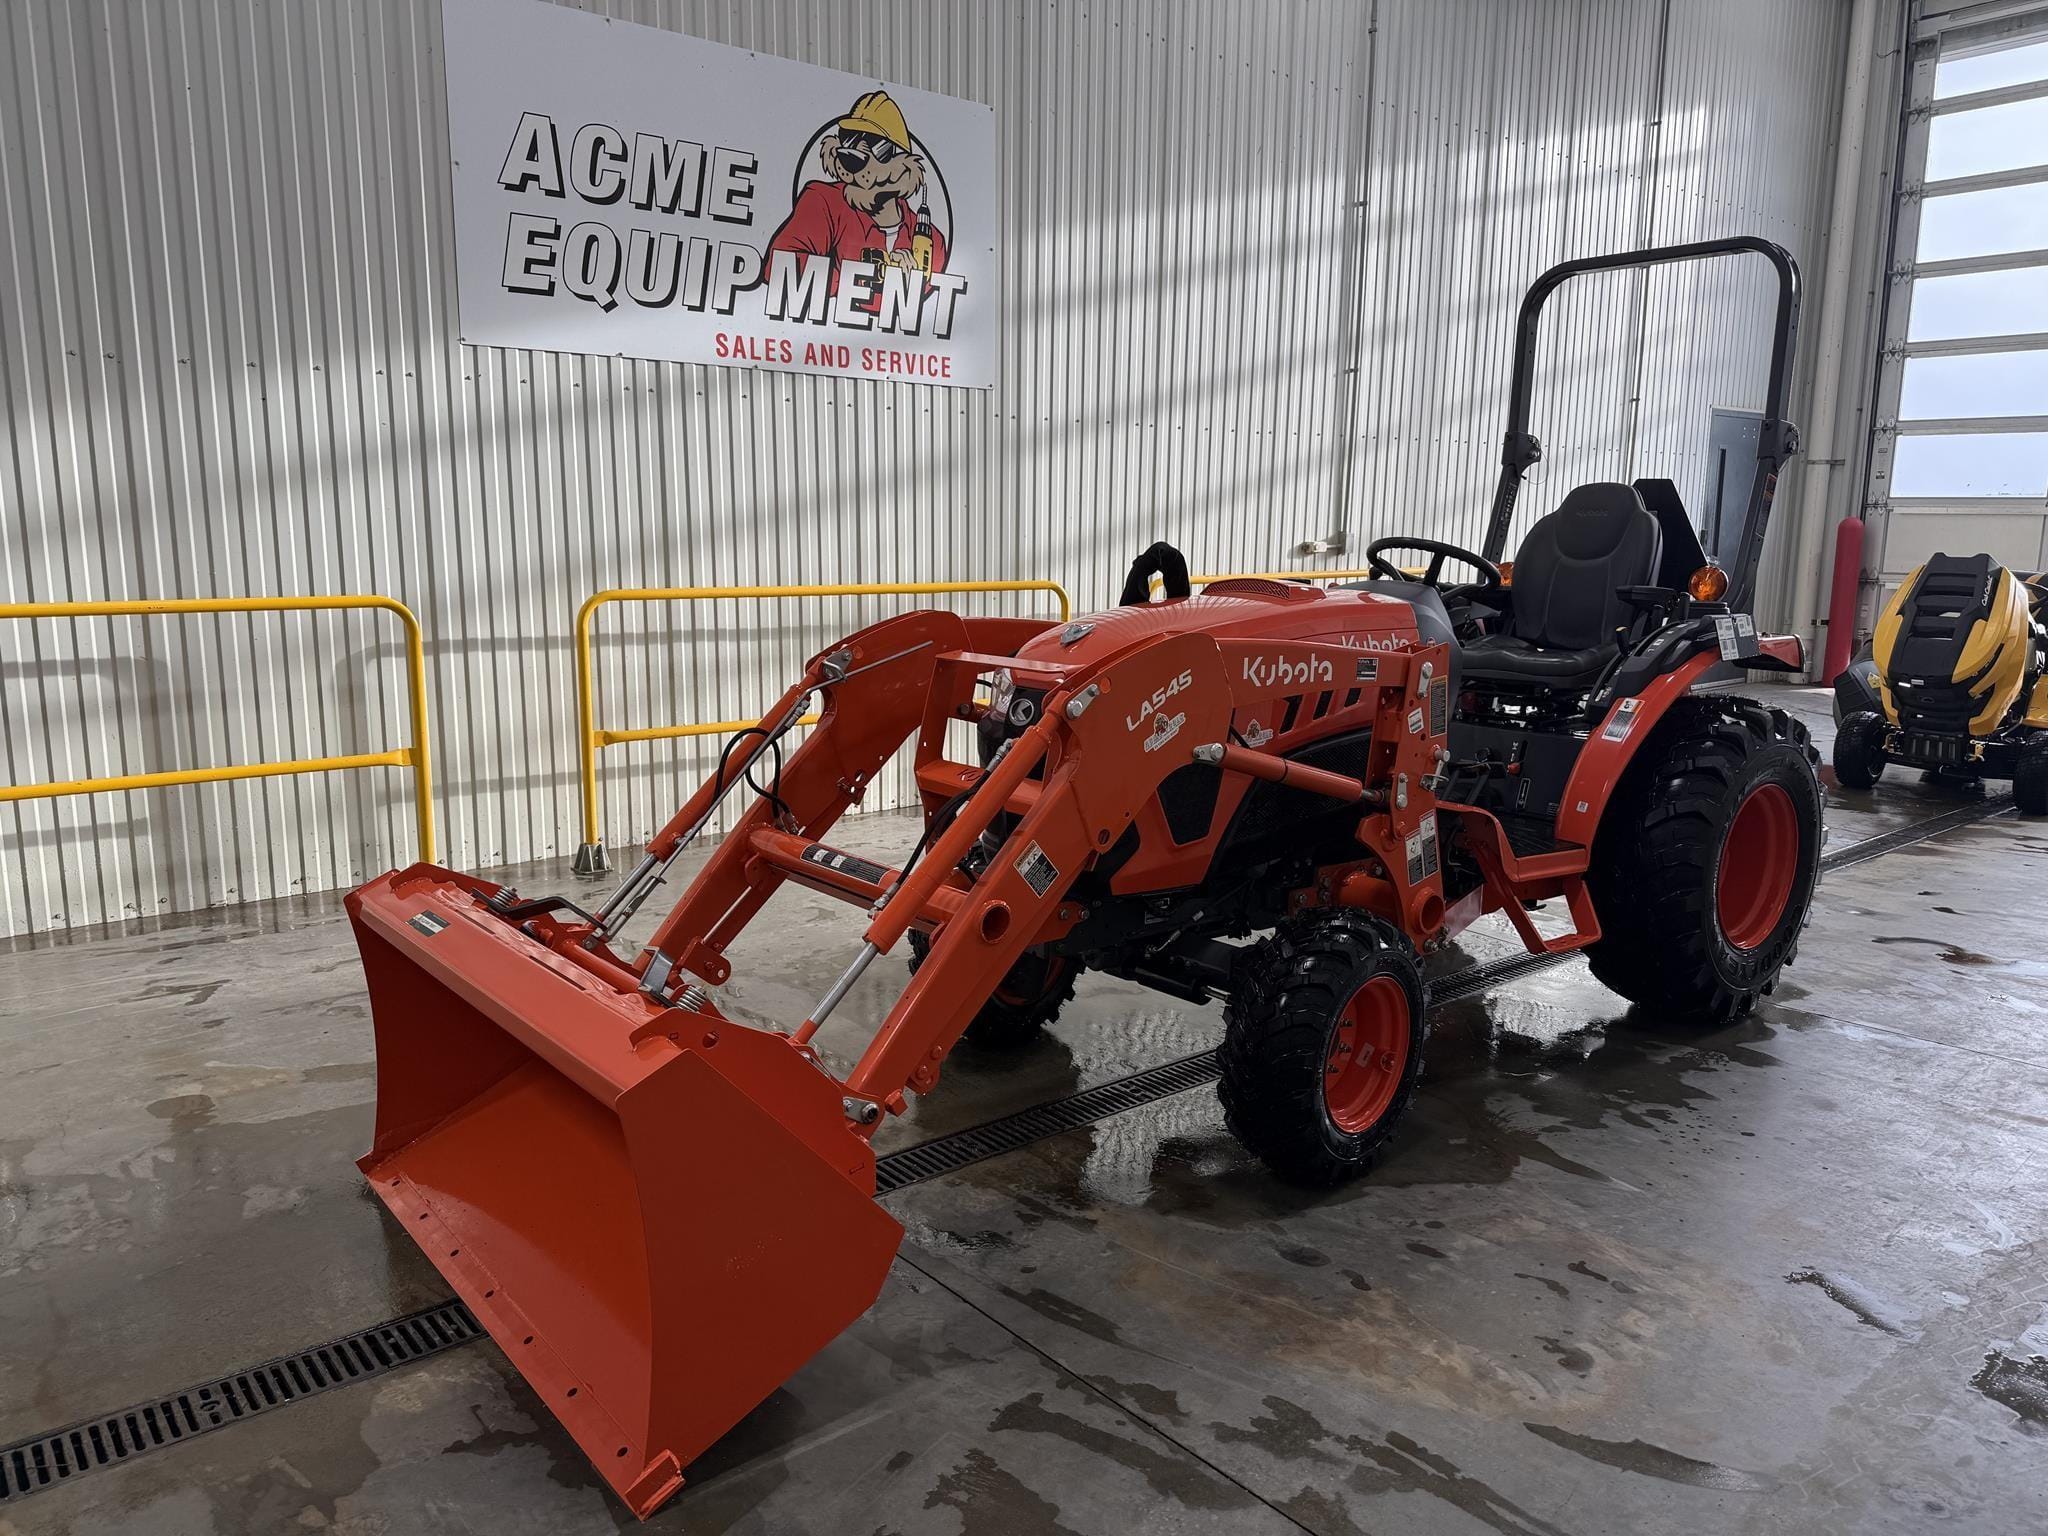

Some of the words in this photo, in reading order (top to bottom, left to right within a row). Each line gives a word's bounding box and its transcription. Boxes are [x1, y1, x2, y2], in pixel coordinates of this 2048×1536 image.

[498, 111, 758, 226] ACME
[502, 212, 968, 340] EQUIPMENT
[715, 332, 793, 364] SALES
[804, 342, 850, 369] AND
[861, 347, 951, 378] SERVICE
[1126, 668, 1193, 732] LA545
[1243, 653, 1333, 687] Kubota
